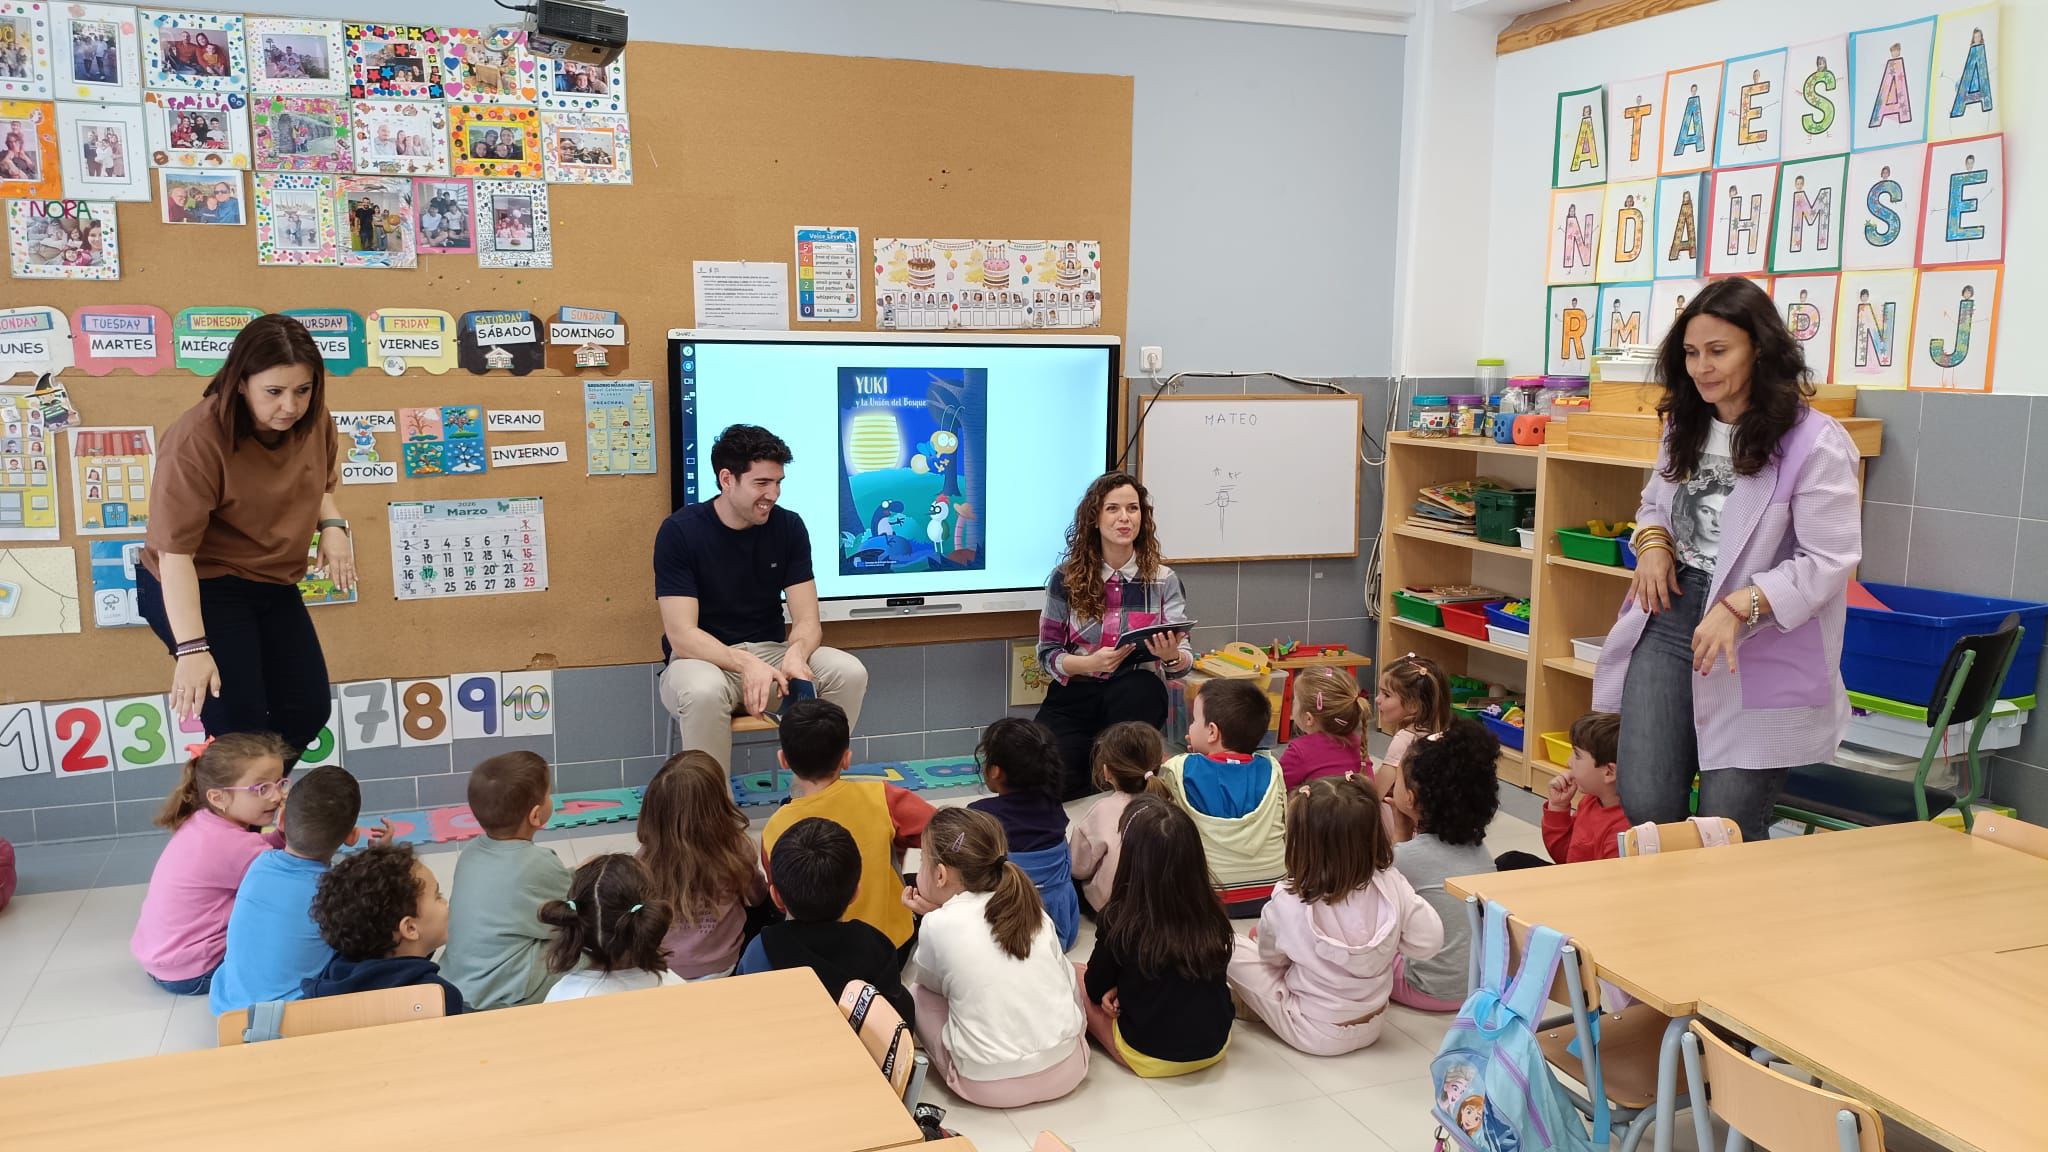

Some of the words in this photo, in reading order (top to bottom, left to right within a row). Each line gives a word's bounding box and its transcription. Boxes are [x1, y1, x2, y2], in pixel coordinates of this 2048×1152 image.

[1570, 117, 1599, 172] A
[1624, 104, 1652, 162] T
[1673, 96, 1705, 157] A
[1738, 81, 1771, 147] E
[1801, 70, 1837, 135] S
[1869, 57, 1913, 129] A
[1950, 42, 1994, 119] A
[30, 200, 92, 220] NORA
[1563, 213, 1593, 269] N
[1614, 207, 1644, 263] D
[1669, 201, 1697, 262] A
[1726, 193, 1762, 256] H
[1789, 186, 1831, 253] M
[1863, 179, 1903, 248] S
[1945, 170, 1988, 243] E
[803, 244, 809, 252] 5
[804, 281, 809, 289] 2
[569, 310, 607, 321] SUNDAY
[804, 306, 811, 314] 0
[0, 315, 38, 330] ONDAY
[93, 318, 141, 330] TUESDAY
[192, 316, 249, 328] WEDNESDAY
[393, 319, 430, 329] FRIDAY
[474, 312, 523, 326] SATURDAY
[478, 325, 531, 339] SÁBADO
[552, 327, 615, 339] DOMINGO
[1560, 308, 1588, 360] R
[1610, 311, 1641, 348] M
[1854, 301, 1896, 368] N
[1929, 299, 1975, 369] J
[0, 342, 44, 354] UNES
[91, 339, 153, 351] MARTES
[380, 338, 439, 350] VIERNES
[855, 376, 888, 395] YUKI
[855, 400, 860, 409] y
[860, 398, 869, 407] la
[869, 397, 890, 407] Unión
[891, 398, 902, 407] del
[903, 397, 927, 409] Bosque
[488, 414, 542, 425] VERANO
[1205, 412, 1257, 426] MATEO
[492, 446, 559, 461] INVIERNO
[342, 464, 394, 478] OTOÑO
[447, 508, 488, 517] Marzo
[423, 539, 430, 549] 3
[443, 538, 450, 548] 4
[464, 537, 471, 547] 5
[484, 536, 490, 546] 6
[503, 535, 510, 545] 7
[523, 534, 530, 544] 8
[404, 555, 411, 565] 9
[422, 553, 433, 564] 10
[443, 552, 452, 563] 11
[463, 551, 474, 562] 12
[483, 550, 493, 561] 13
[502, 549, 513, 560] 14
[522, 548, 533, 558] 15
[403, 569, 414, 580] 16
[422, 568, 434, 579] 17
[443, 567, 454, 578] 18
[464, 566, 475, 576] 19
[483, 564, 496, 575] 20
[503, 563, 514, 574] 21
[523, 562, 534, 572] 22
[444, 582, 456, 593] 25
[464, 580, 477, 591] 26
[484, 579, 496, 590] 27
[504, 578, 516, 589] 28
[523, 577, 536, 587] 29
[0, 707, 39, 772] 1
[54, 706, 108, 772] 2
[115, 702, 167, 765] 3
[343, 682, 390, 745] 7
[403, 681, 447, 741] 8
[457, 676, 498, 735] 9
[502, 684, 549, 721] 10
